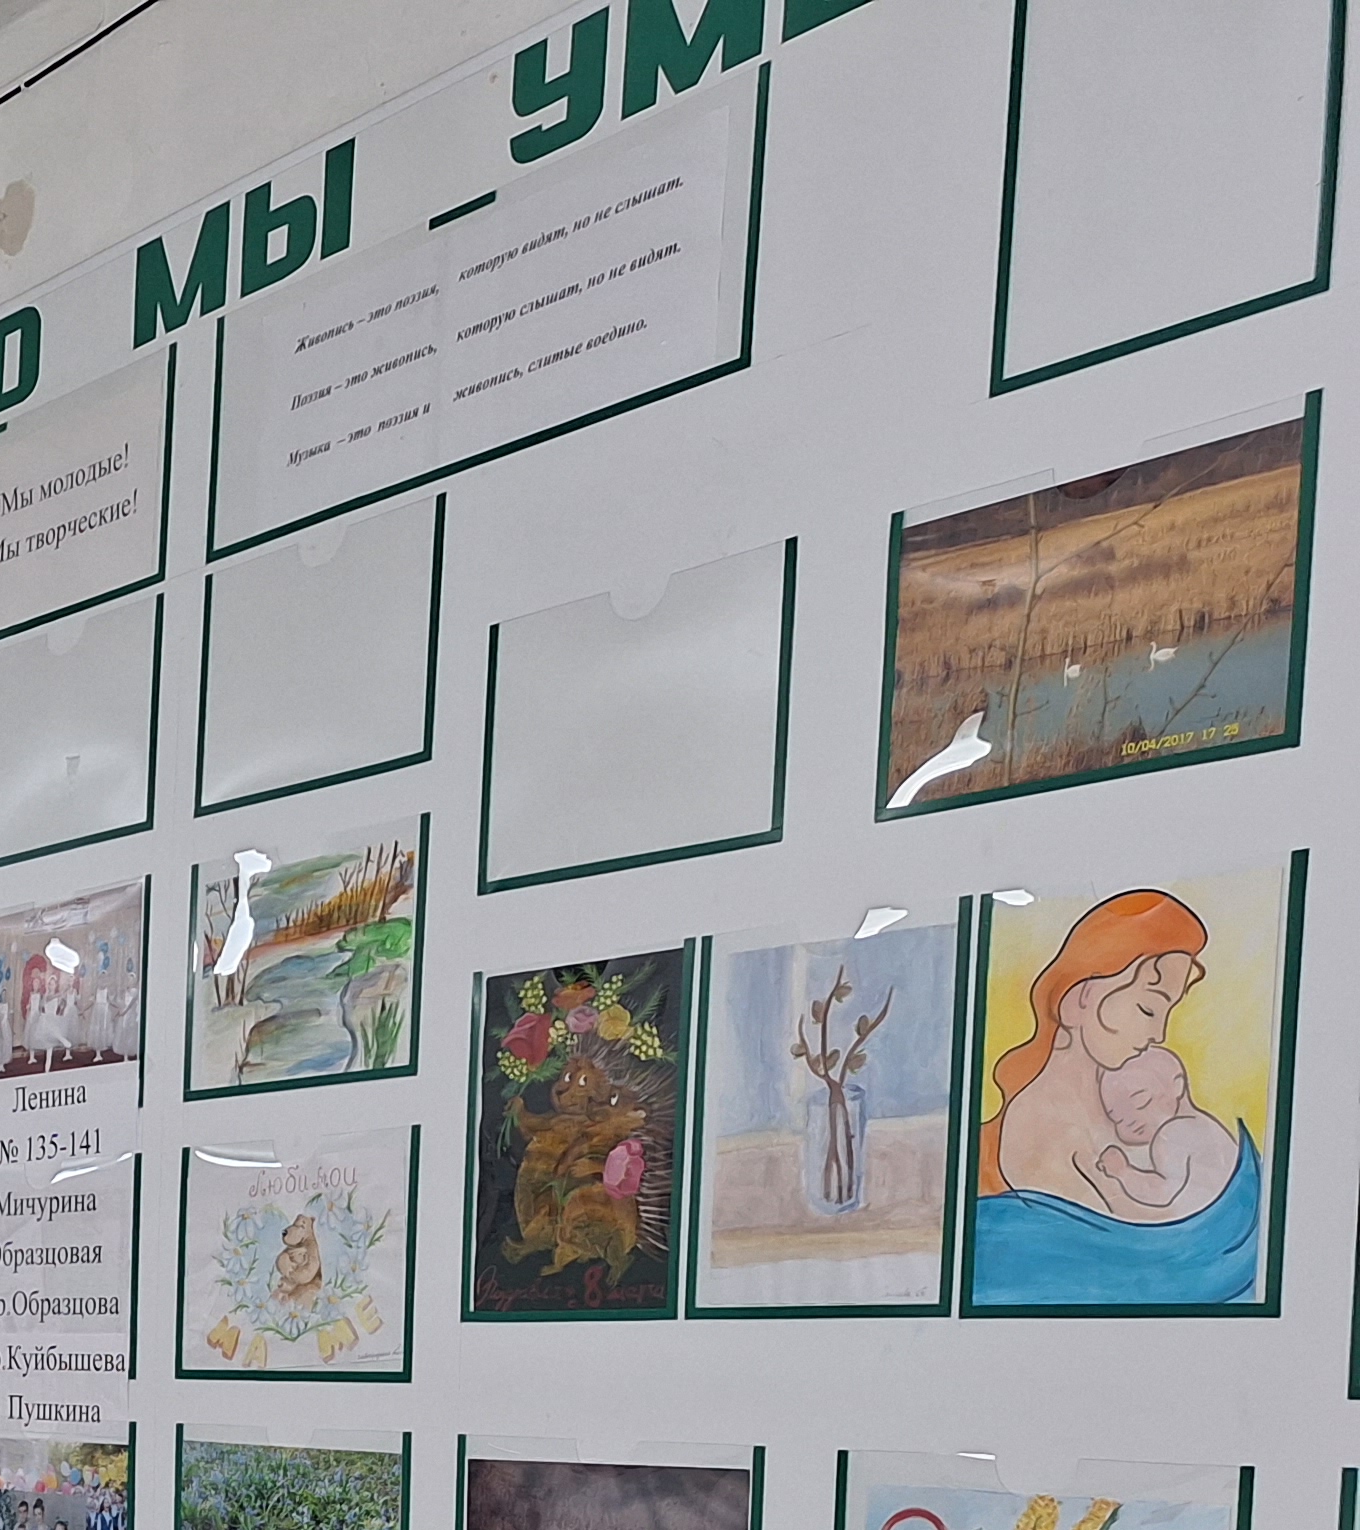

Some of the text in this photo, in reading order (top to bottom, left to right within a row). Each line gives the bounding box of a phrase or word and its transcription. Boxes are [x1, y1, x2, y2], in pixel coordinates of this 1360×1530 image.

[132, 136, 356, 350] МЫ
[509, 0, 877, 165] УМ
[294, 320, 355, 354] Живопись
[366, 303, 392, 324] это
[394, 284, 439, 312] поэзия,
[458, 246, 519, 282] которую
[521, 226, 569, 255] видят,
[572, 215, 591, 233] но
[594, 206, 612, 224] не
[614, 176, 684, 214] слышат.
[290, 385, 332, 411] Поэзия
[344, 371, 368, 390] это
[370, 344, 438, 379] живопись,
[456, 309, 516, 342] которую
[519, 282, 582, 317] слышат,
[586, 272, 605, 290] но
[608, 263, 627, 281] не
[629, 241, 682, 273] видят.
[286, 441, 331, 468] Музыка
[347, 425, 372, 444] это
[377, 406, 419, 433] поэзия
[422, 402, 431, 415] и
[452, 367, 524, 403] живопись,
[527, 342, 583, 374] слитые
[586, 317, 648, 351] воедино.
[0, 442, 130, 518] Мы молодые!
[26, 489, 139, 555] творческие!
[1121, 731, 1195, 756] 10/04/2017
[1202, 726, 1217, 741] 17
[12, 1084, 87, 1114] Ленина
[25, 1128, 102, 1163] 135-141
[7, 1394, 101, 1427] Пушкина
